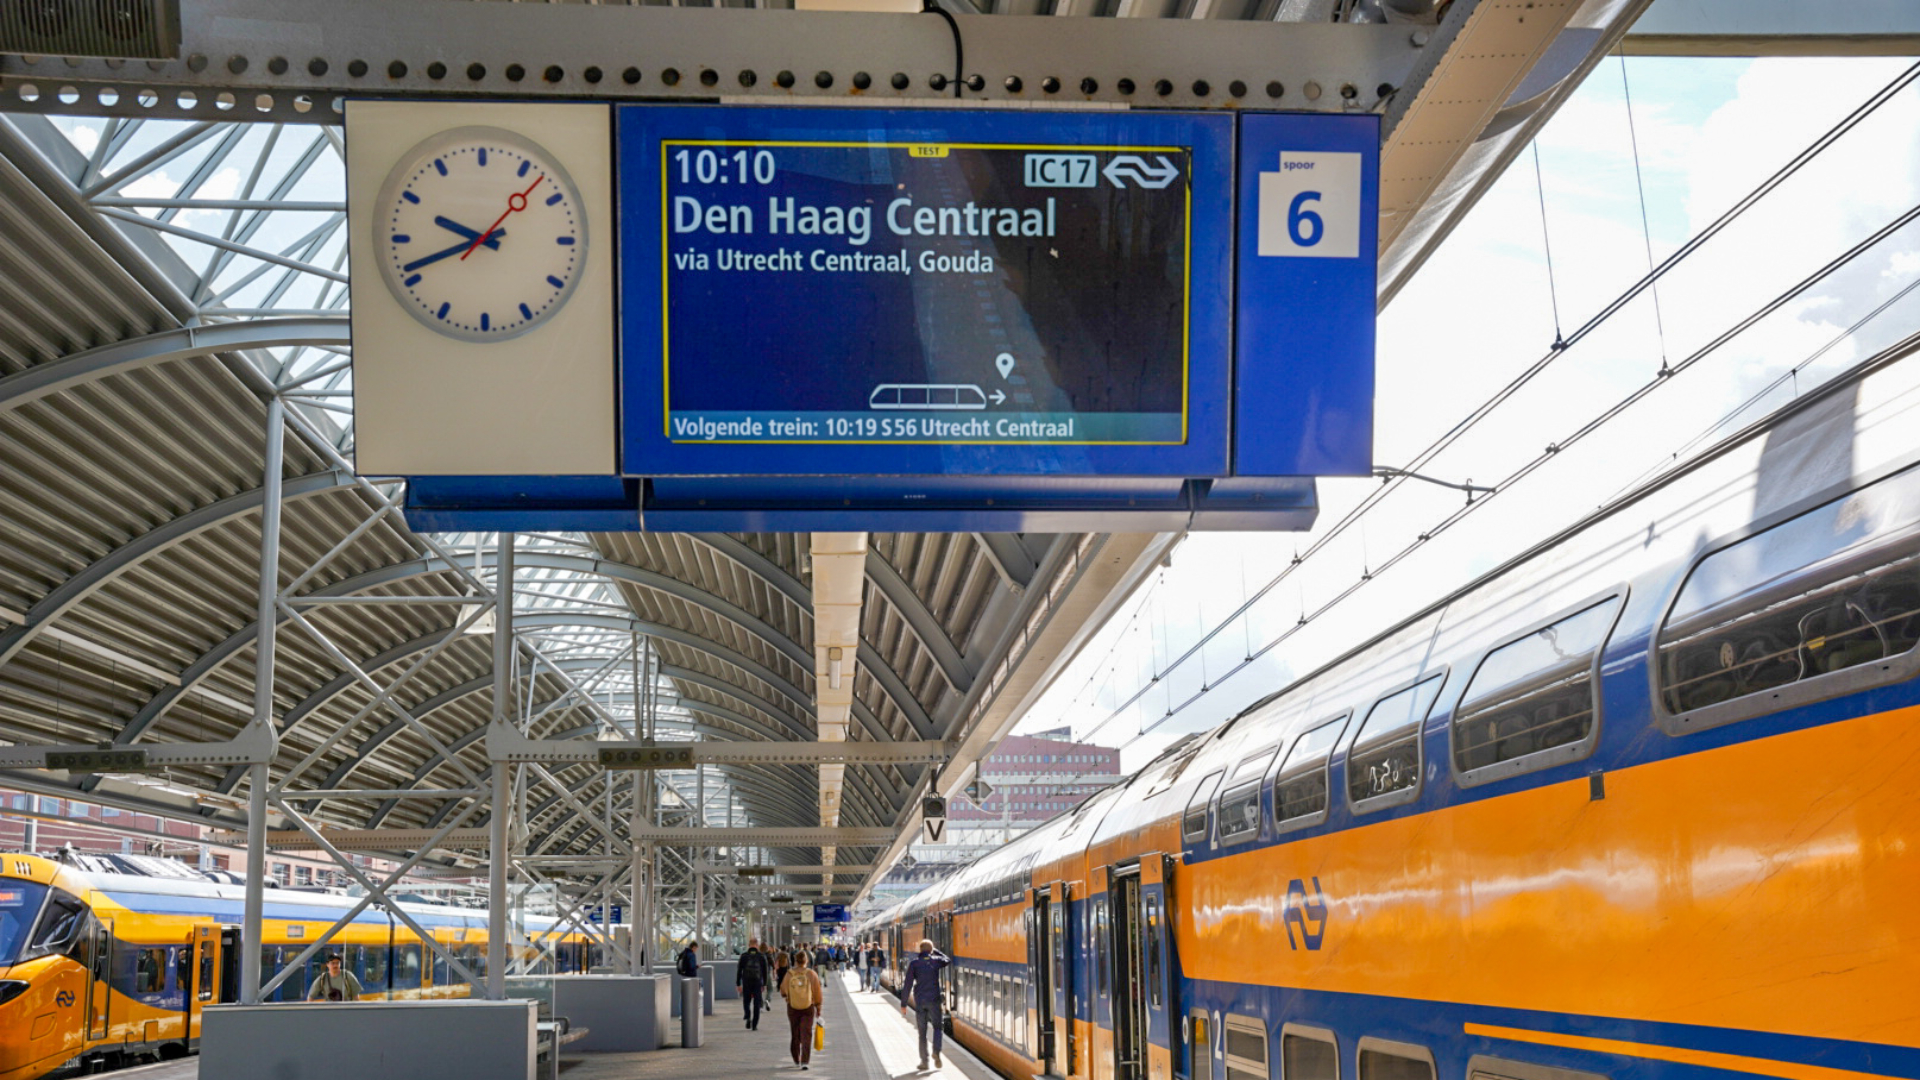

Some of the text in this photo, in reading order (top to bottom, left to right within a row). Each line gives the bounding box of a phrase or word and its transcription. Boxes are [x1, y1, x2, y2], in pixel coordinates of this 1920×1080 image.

[918, 147, 940, 156] TEST
[675, 150, 775, 184] 10:10
[1031, 159, 1091, 184] IC17
[1283, 162, 1315, 171] spoor
[674, 196, 1056, 245] Den Haag Centraal
[1288, 190, 1324, 247] 6
[675, 248, 994, 275] via Utrecht Centraal, Gouda
[674, 417, 762, 440] Volgende
[769, 418, 819, 436] trein:
[826, 418, 877, 436] 10:19
[922, 418, 990, 437] Utrecht
[996, 418, 1074, 437] Centraal
[926, 820, 944, 841] V
[169, 946, 175, 967] 2
[1214, 1010, 1222, 1060] 2
